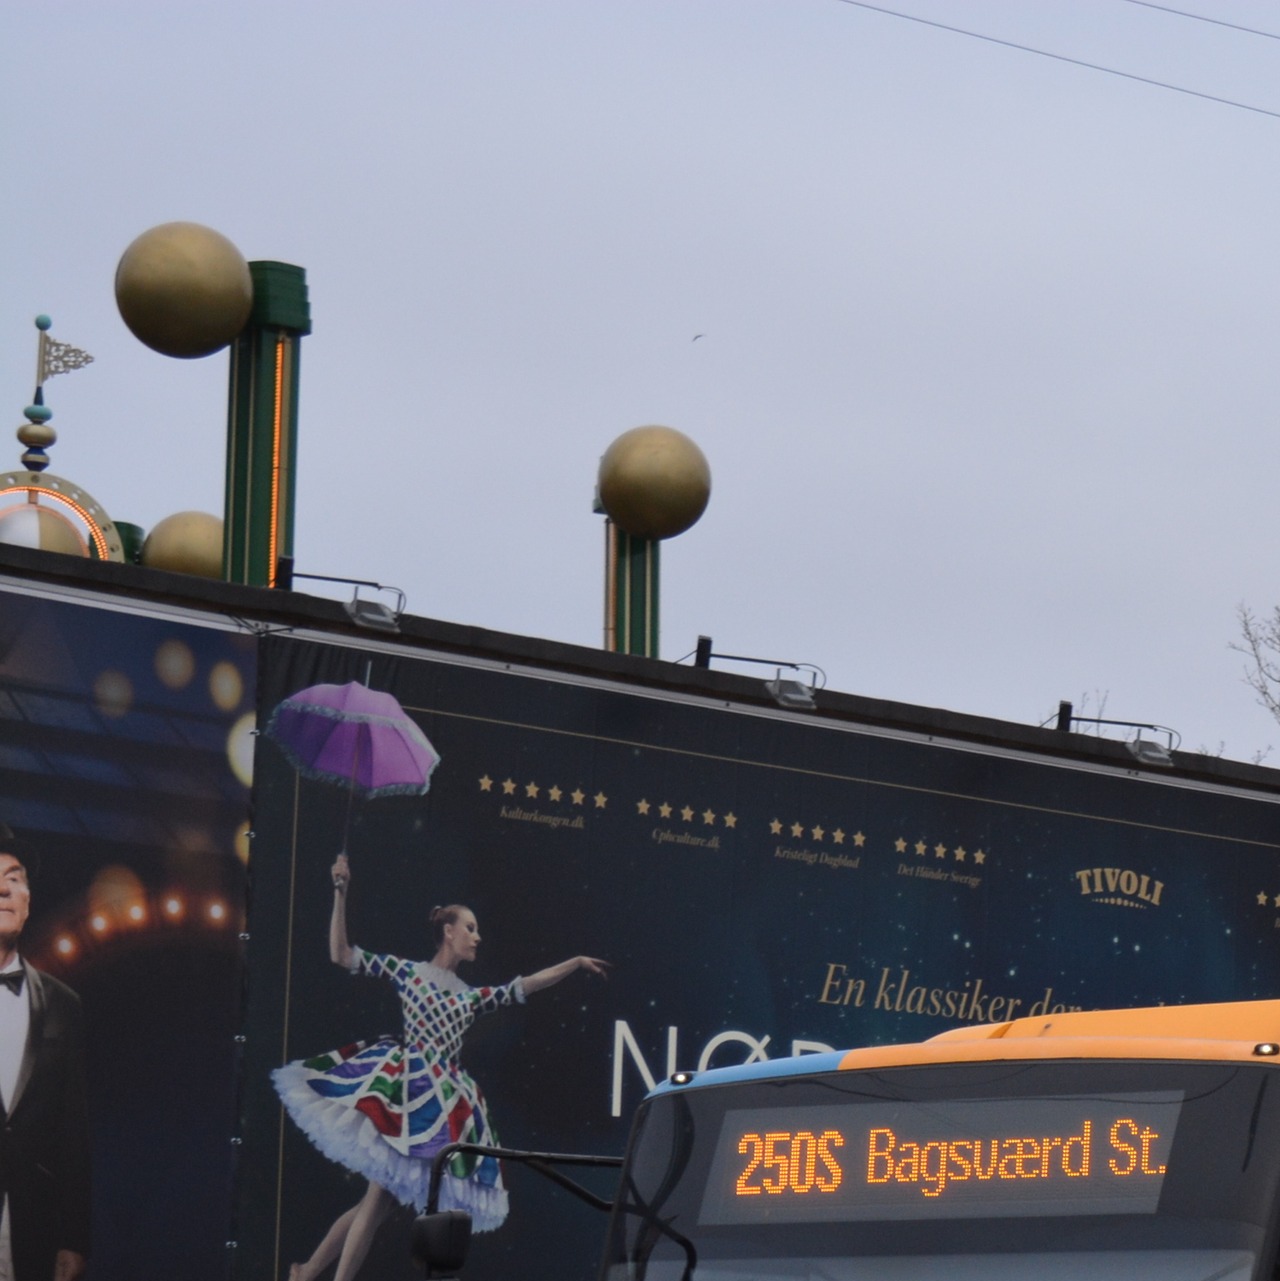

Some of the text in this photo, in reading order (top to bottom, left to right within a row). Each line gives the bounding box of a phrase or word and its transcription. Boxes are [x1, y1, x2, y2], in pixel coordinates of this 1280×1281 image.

[1076, 868, 1164, 906] TIVOLI
[819, 963, 867, 1007] En
[873, 967, 1022, 1024] klassiker
[736, 1119, 1167, 1197] 250S Bagsværd St.
